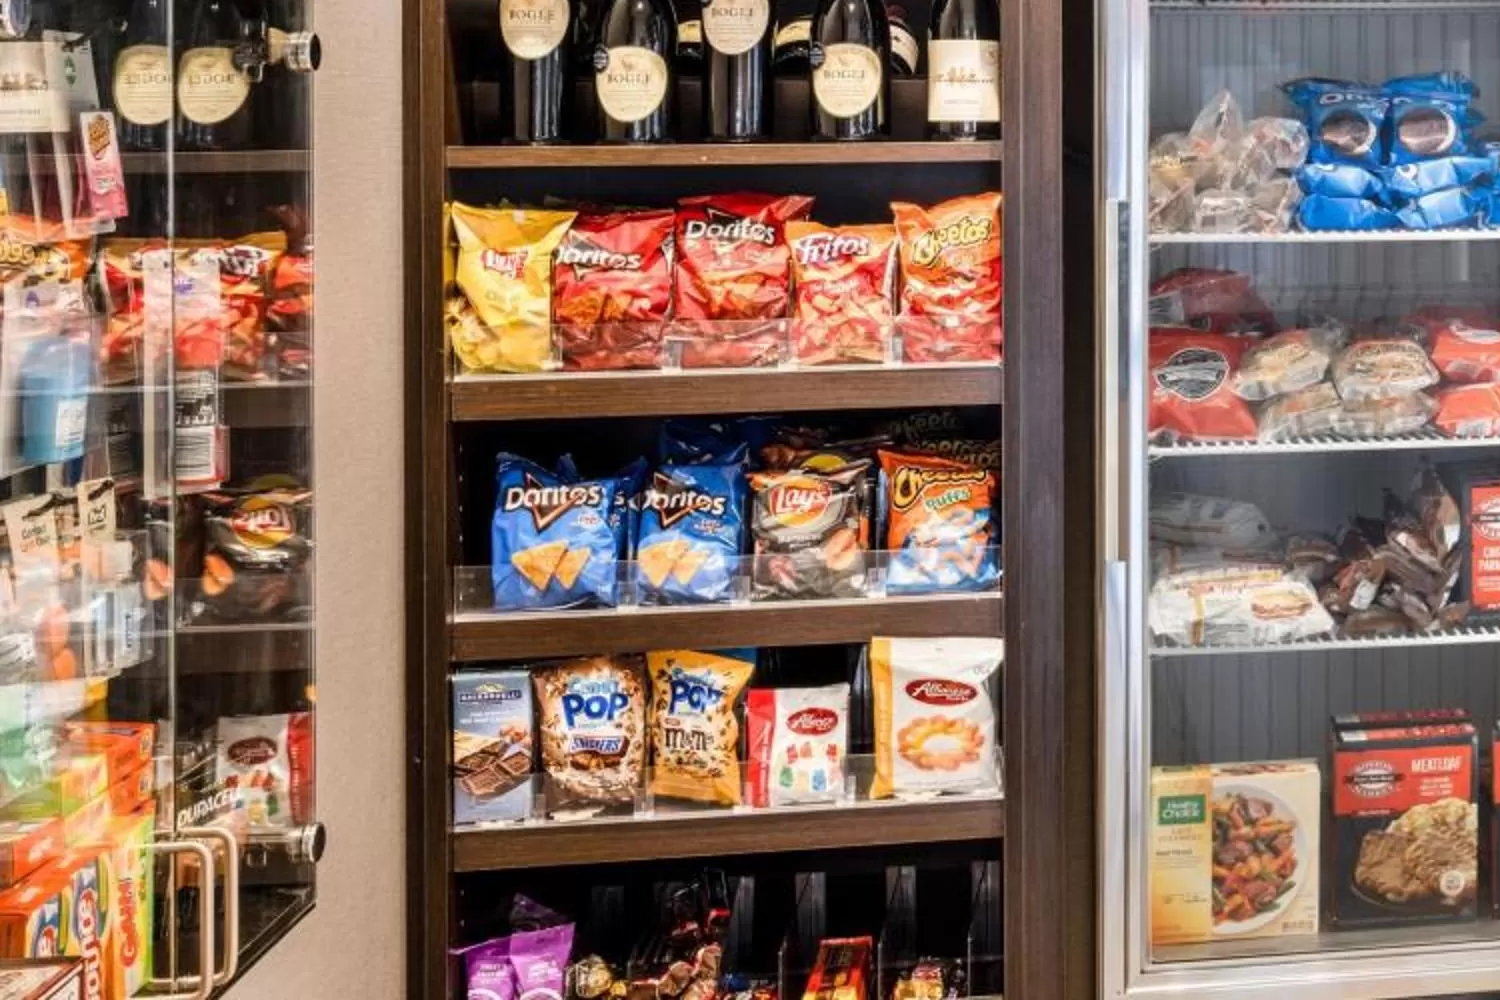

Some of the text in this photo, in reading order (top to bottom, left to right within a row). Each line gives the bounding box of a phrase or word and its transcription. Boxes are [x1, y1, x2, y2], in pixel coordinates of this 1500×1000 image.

[685, 219, 777, 246] Doritos
[799, 231, 870, 265] Fritos
[911, 215, 993, 266] Cheetos
[504, 484, 604, 512] Doritos
[561, 692, 630, 728] POP
[668, 679, 726, 715] POP
